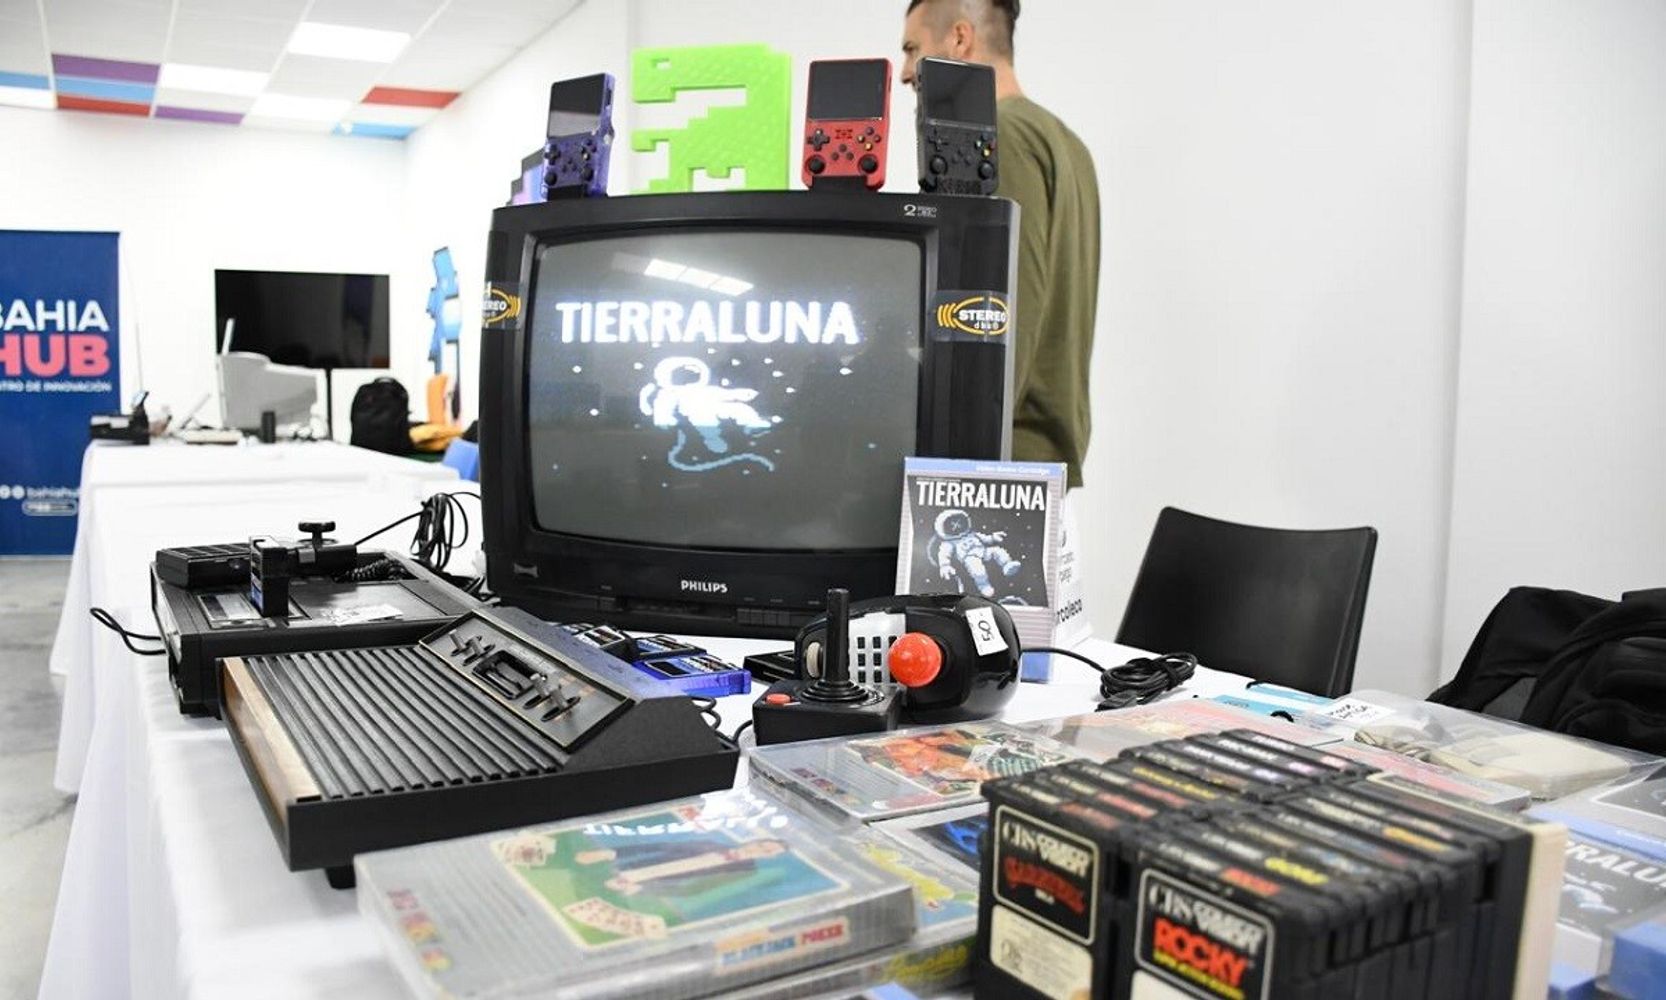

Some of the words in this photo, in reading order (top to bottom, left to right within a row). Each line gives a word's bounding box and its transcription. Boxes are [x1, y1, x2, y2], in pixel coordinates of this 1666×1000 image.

[903, 204, 917, 217] 2
[0, 299, 109, 331] AHIA
[556, 301, 859, 345] TIERRALUNA
[959, 309, 1006, 323] STEREO
[916, 481, 1046, 511] TIERRALUNA
[681, 580, 728, 593] PHILIPS
[1154, 916, 1248, 987] ROCKY
